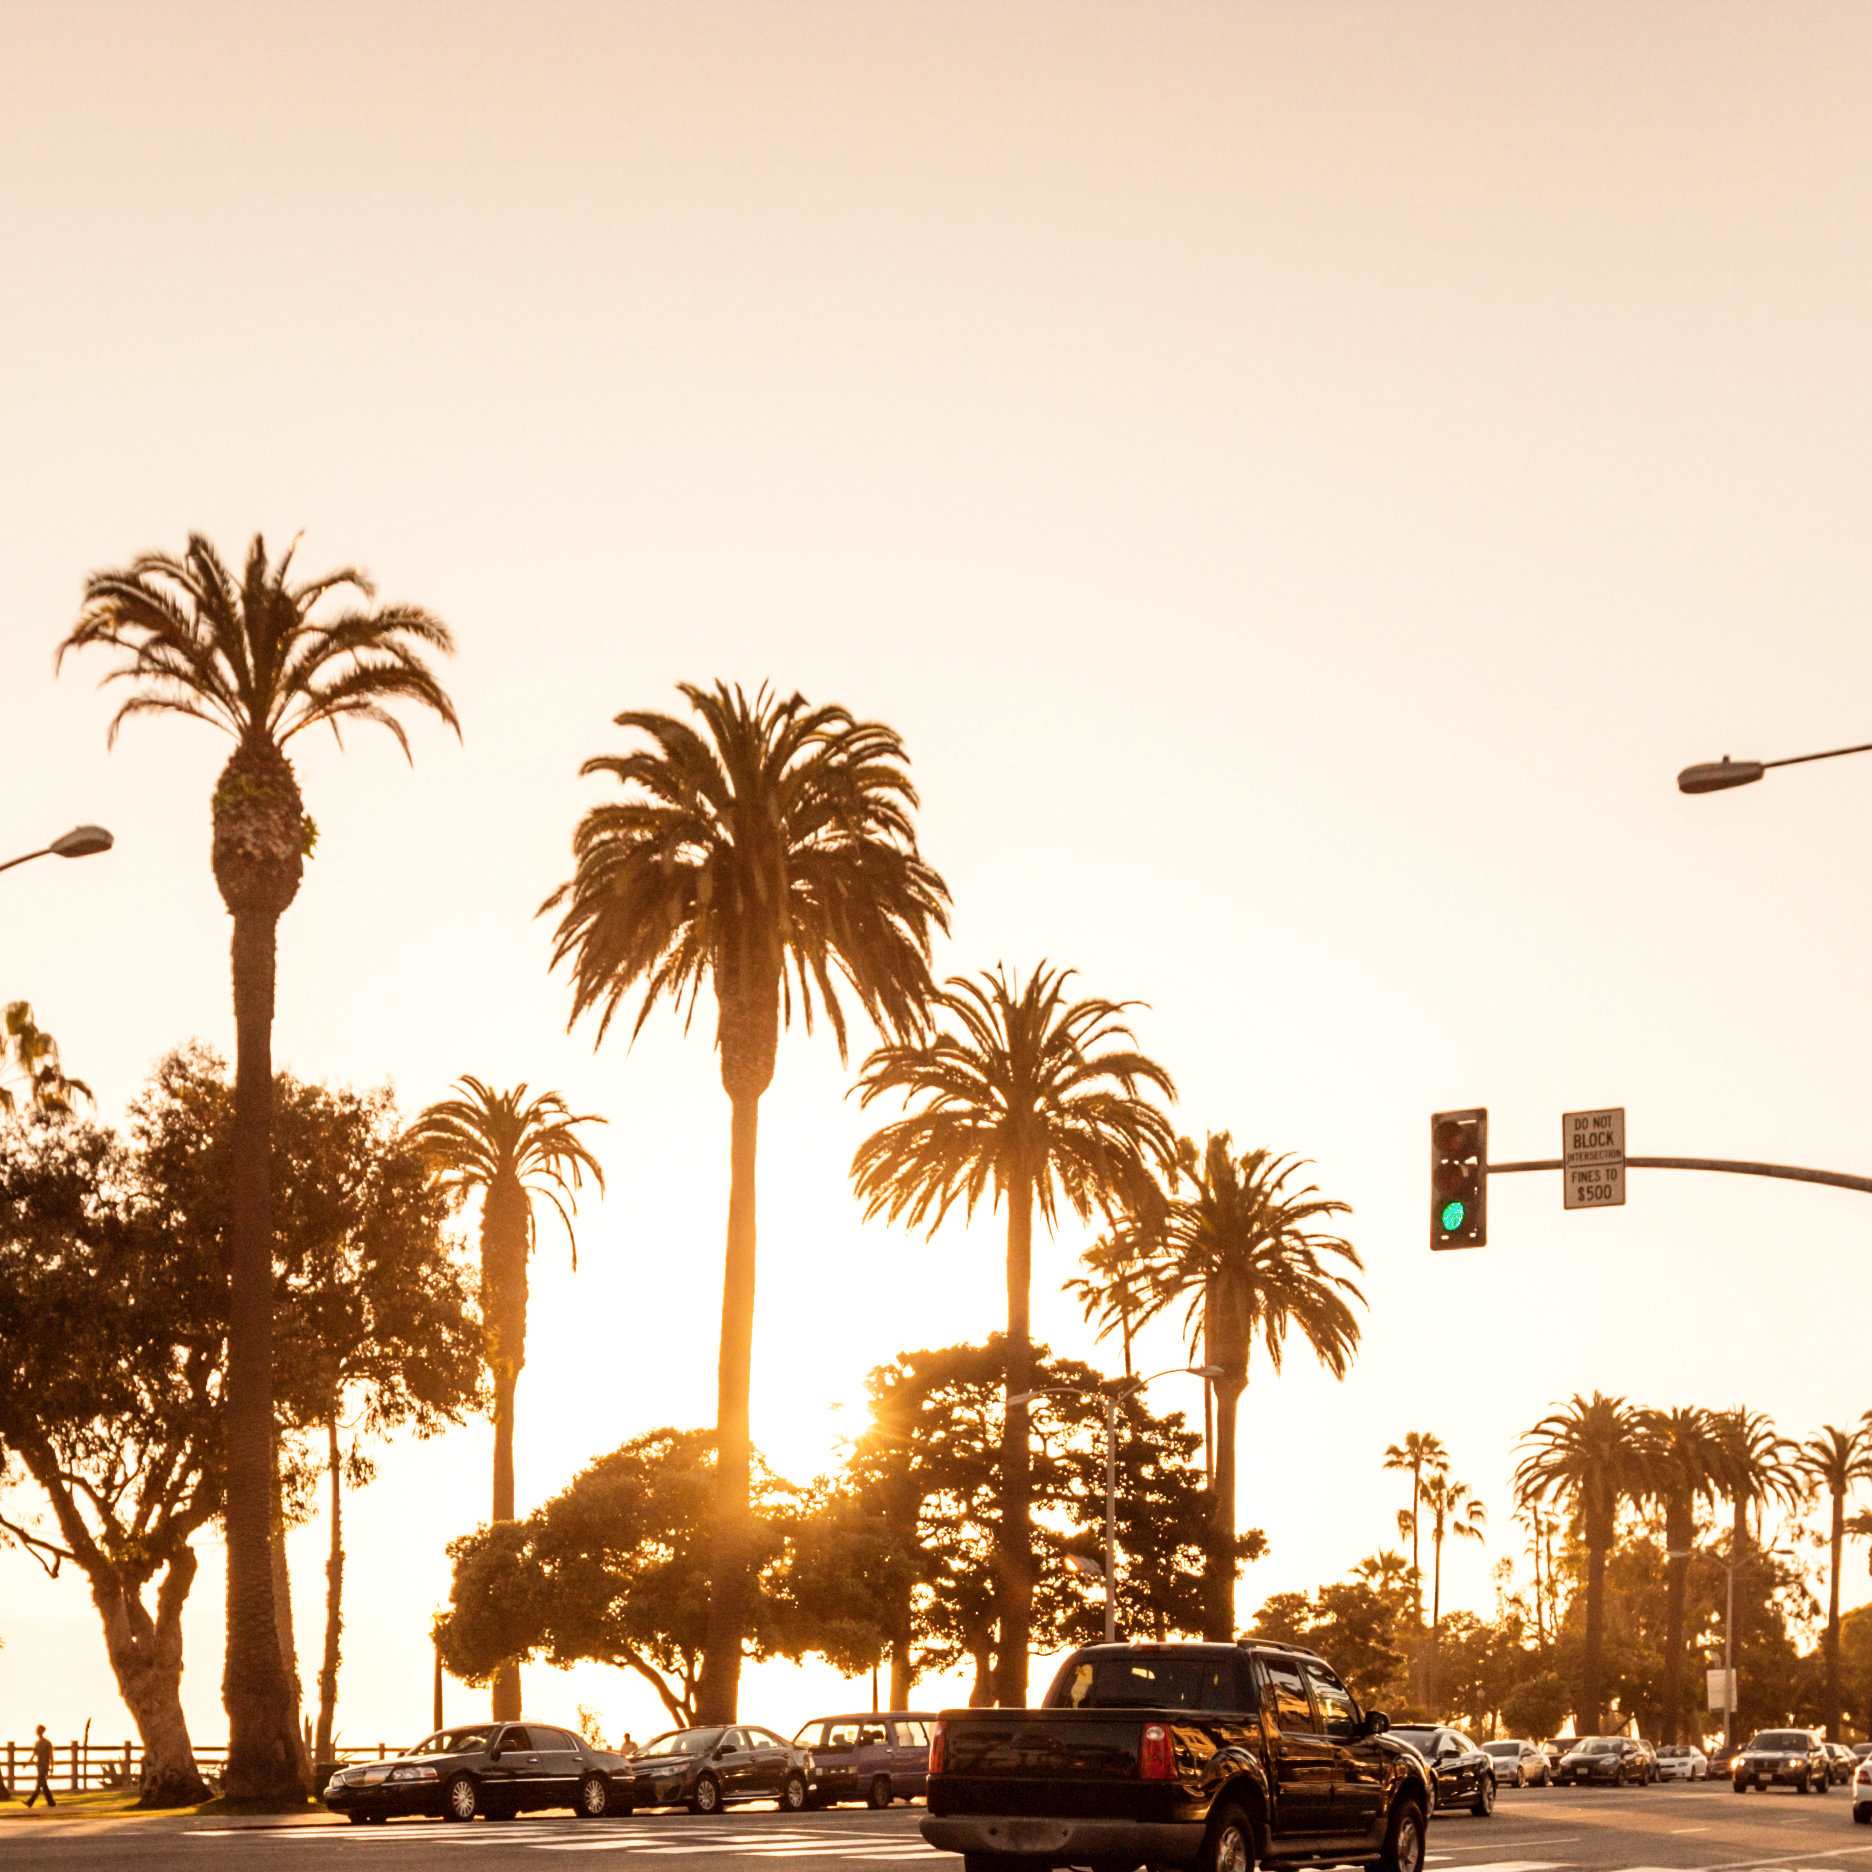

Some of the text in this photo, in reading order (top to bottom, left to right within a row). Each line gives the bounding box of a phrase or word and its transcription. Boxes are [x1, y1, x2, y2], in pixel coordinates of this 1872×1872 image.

[1574, 1115, 1613, 1131] DO NOT
[1573, 1131, 1615, 1149] BLOCK
[1567, 1149, 1622, 1163] INTERSECTION
[1571, 1168, 1618, 1184] FINES TO
[1577, 1184, 1612, 1202] $500
